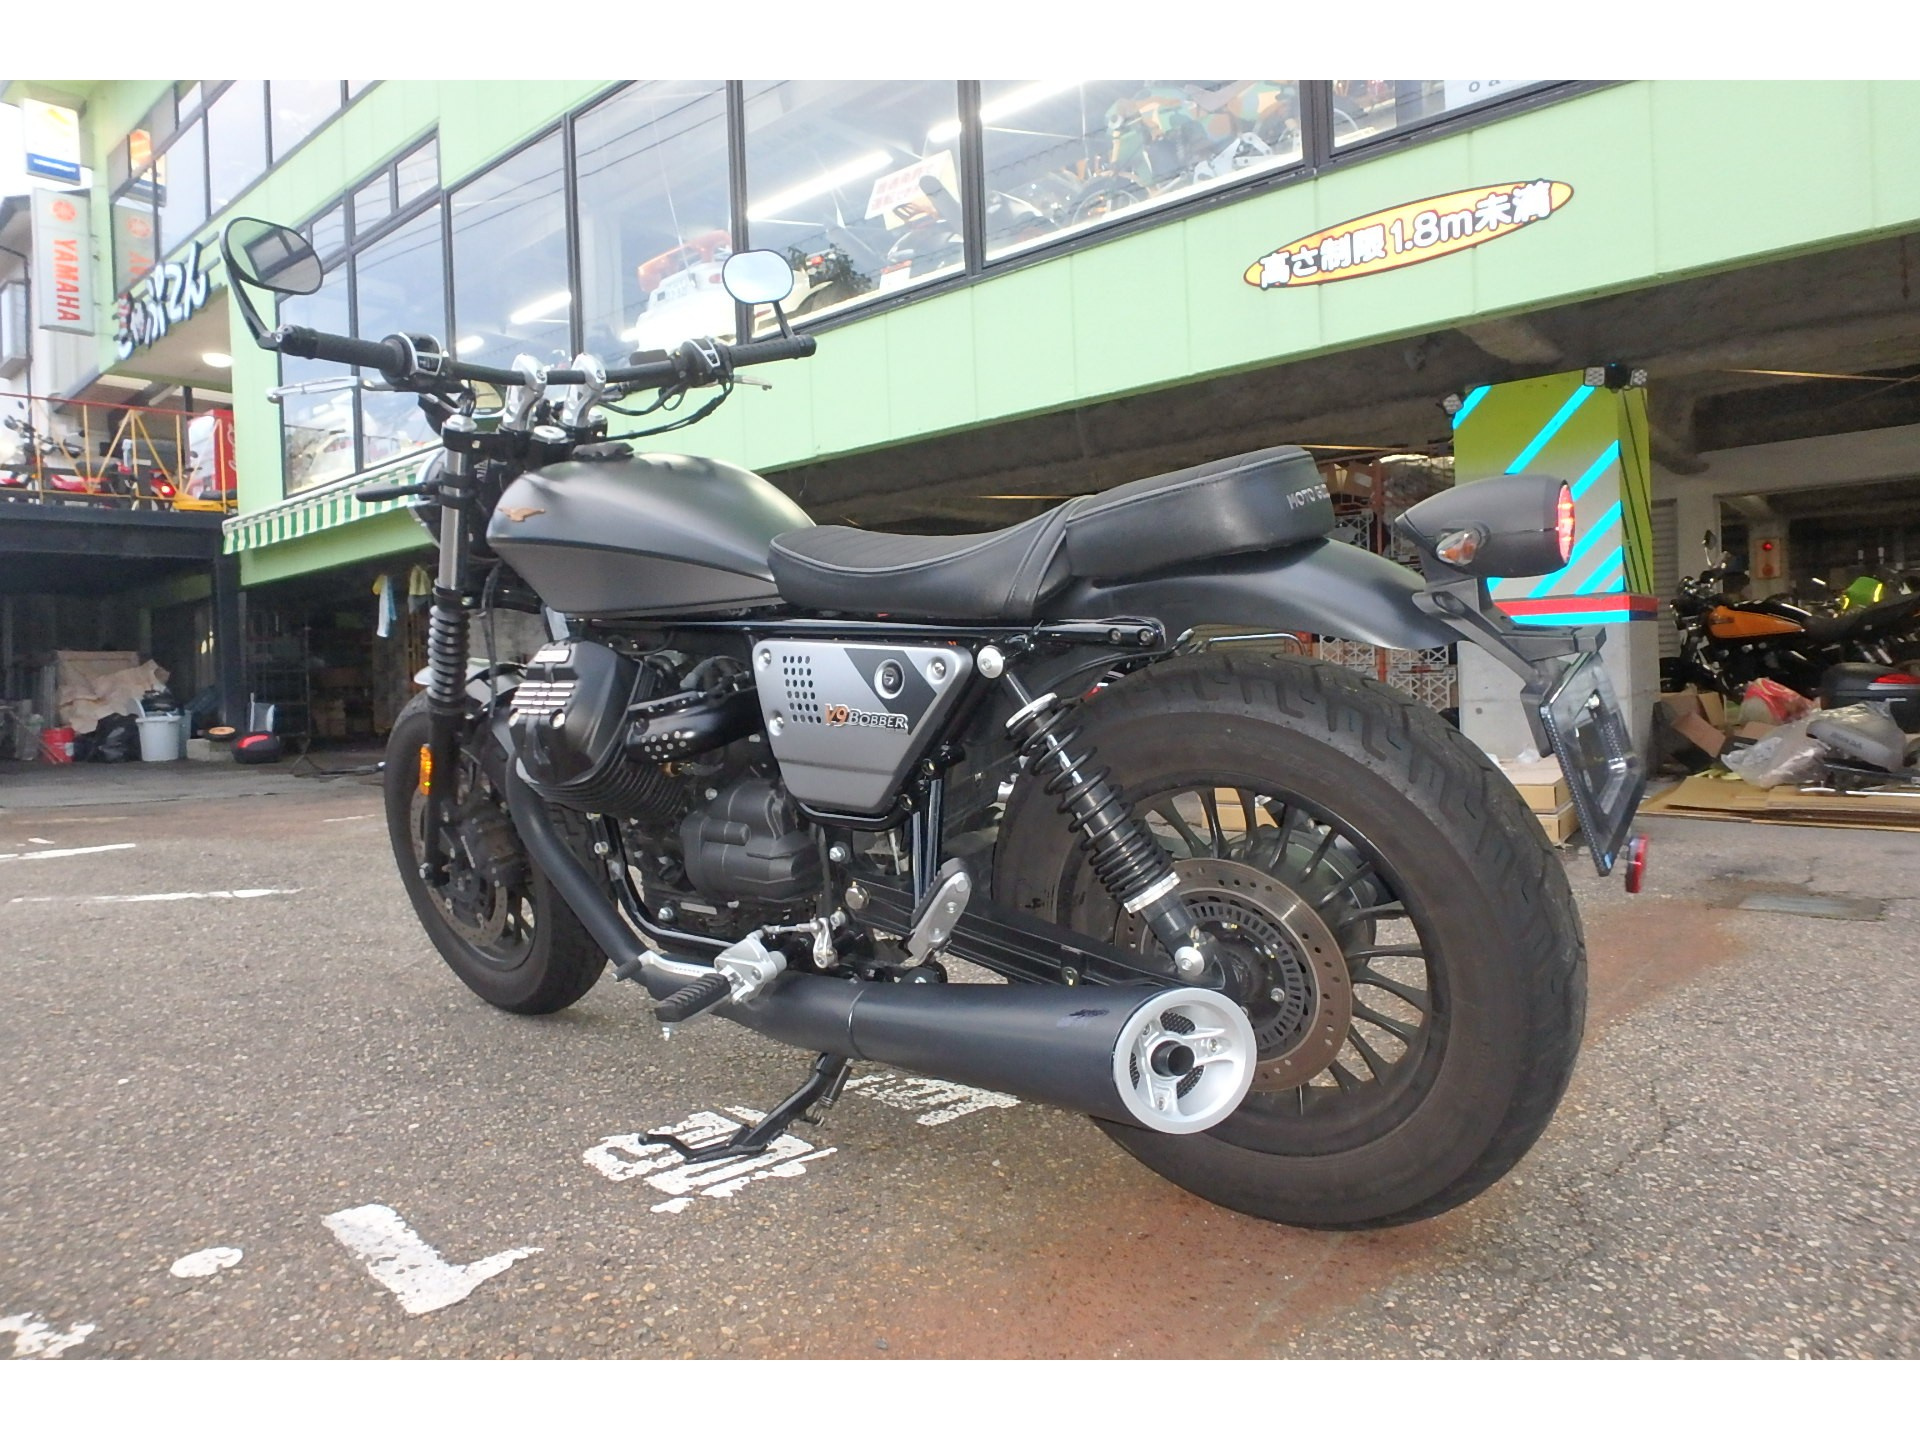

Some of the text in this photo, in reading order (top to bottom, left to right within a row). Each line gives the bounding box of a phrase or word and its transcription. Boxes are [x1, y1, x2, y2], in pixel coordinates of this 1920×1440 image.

[54, 240, 80, 320] YAMAHA
[825, 704, 907, 729] V9 BOBBER
